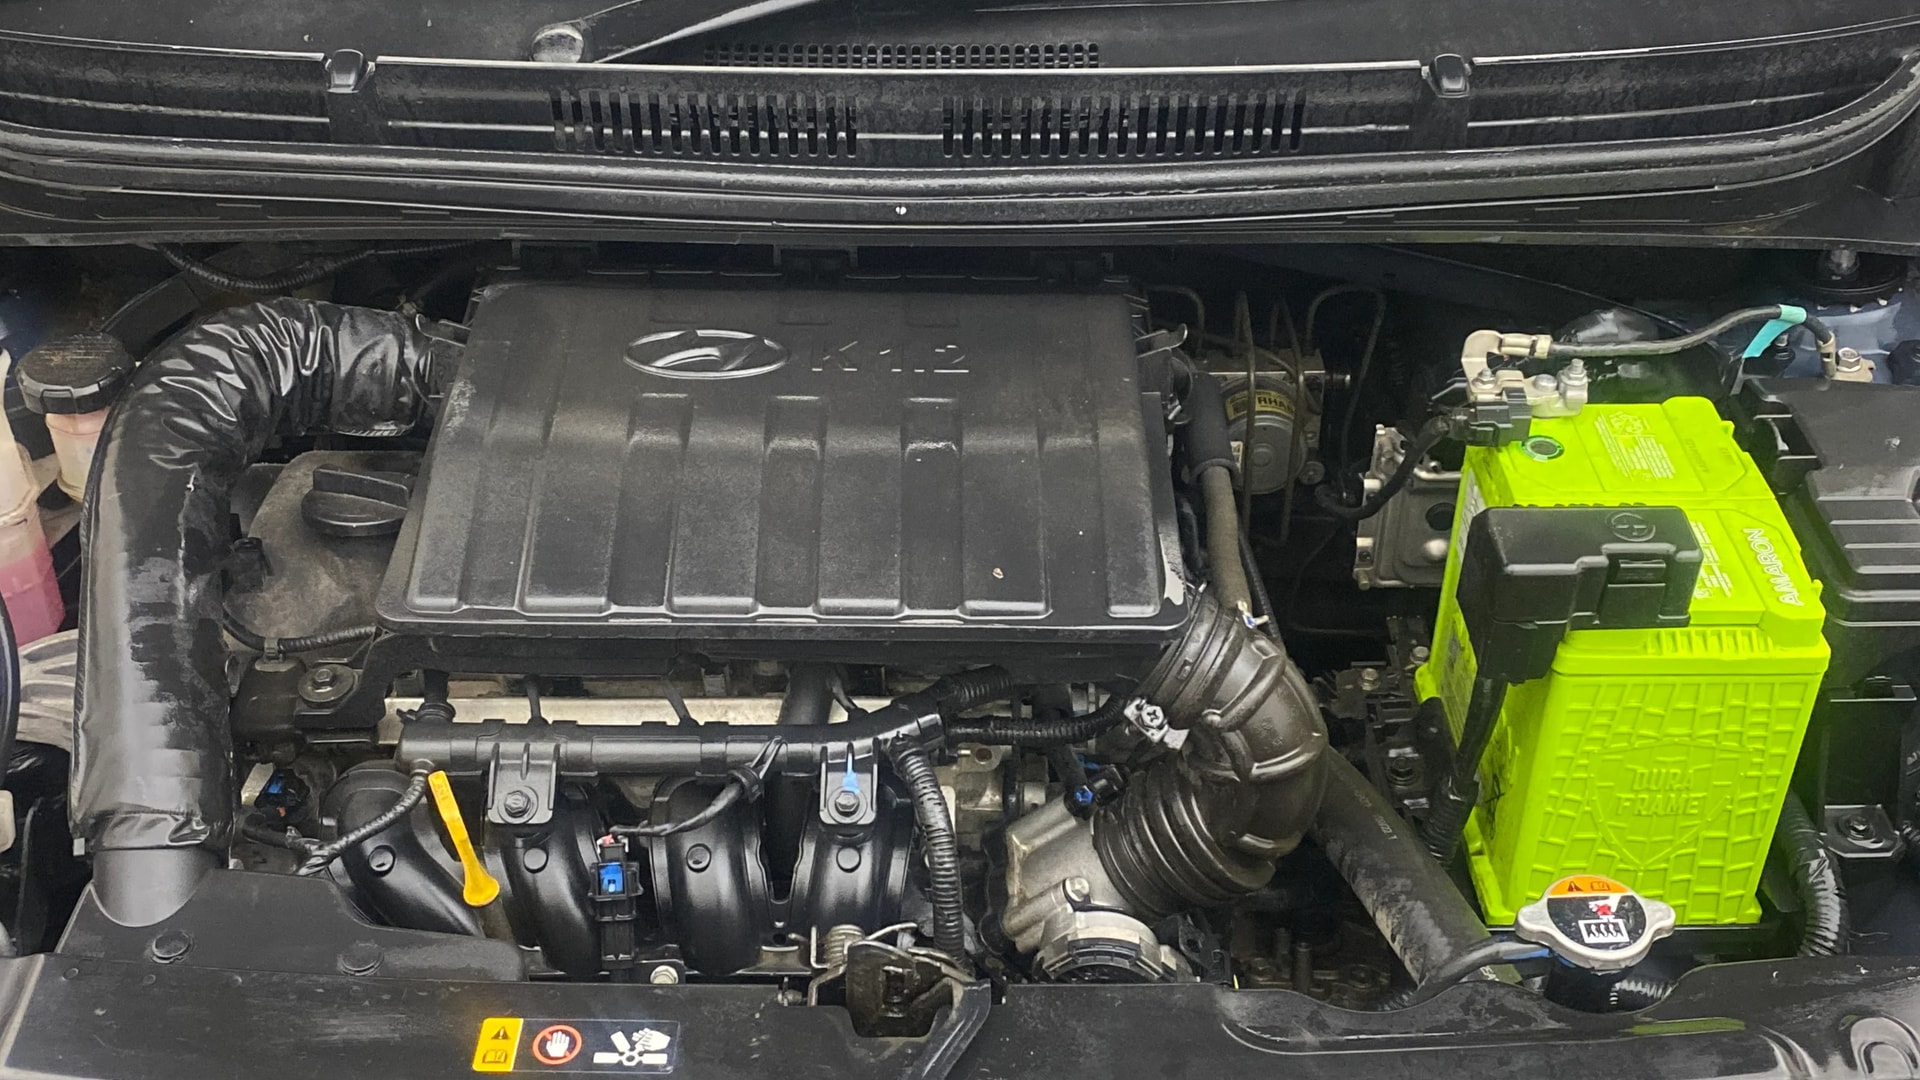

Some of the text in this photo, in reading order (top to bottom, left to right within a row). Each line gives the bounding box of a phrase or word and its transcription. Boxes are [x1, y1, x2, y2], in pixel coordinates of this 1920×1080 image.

[1743, 528, 1805, 606] AMARON
[1632, 768, 1694, 791] DURA
[1616, 792, 1702, 815] FRAME
